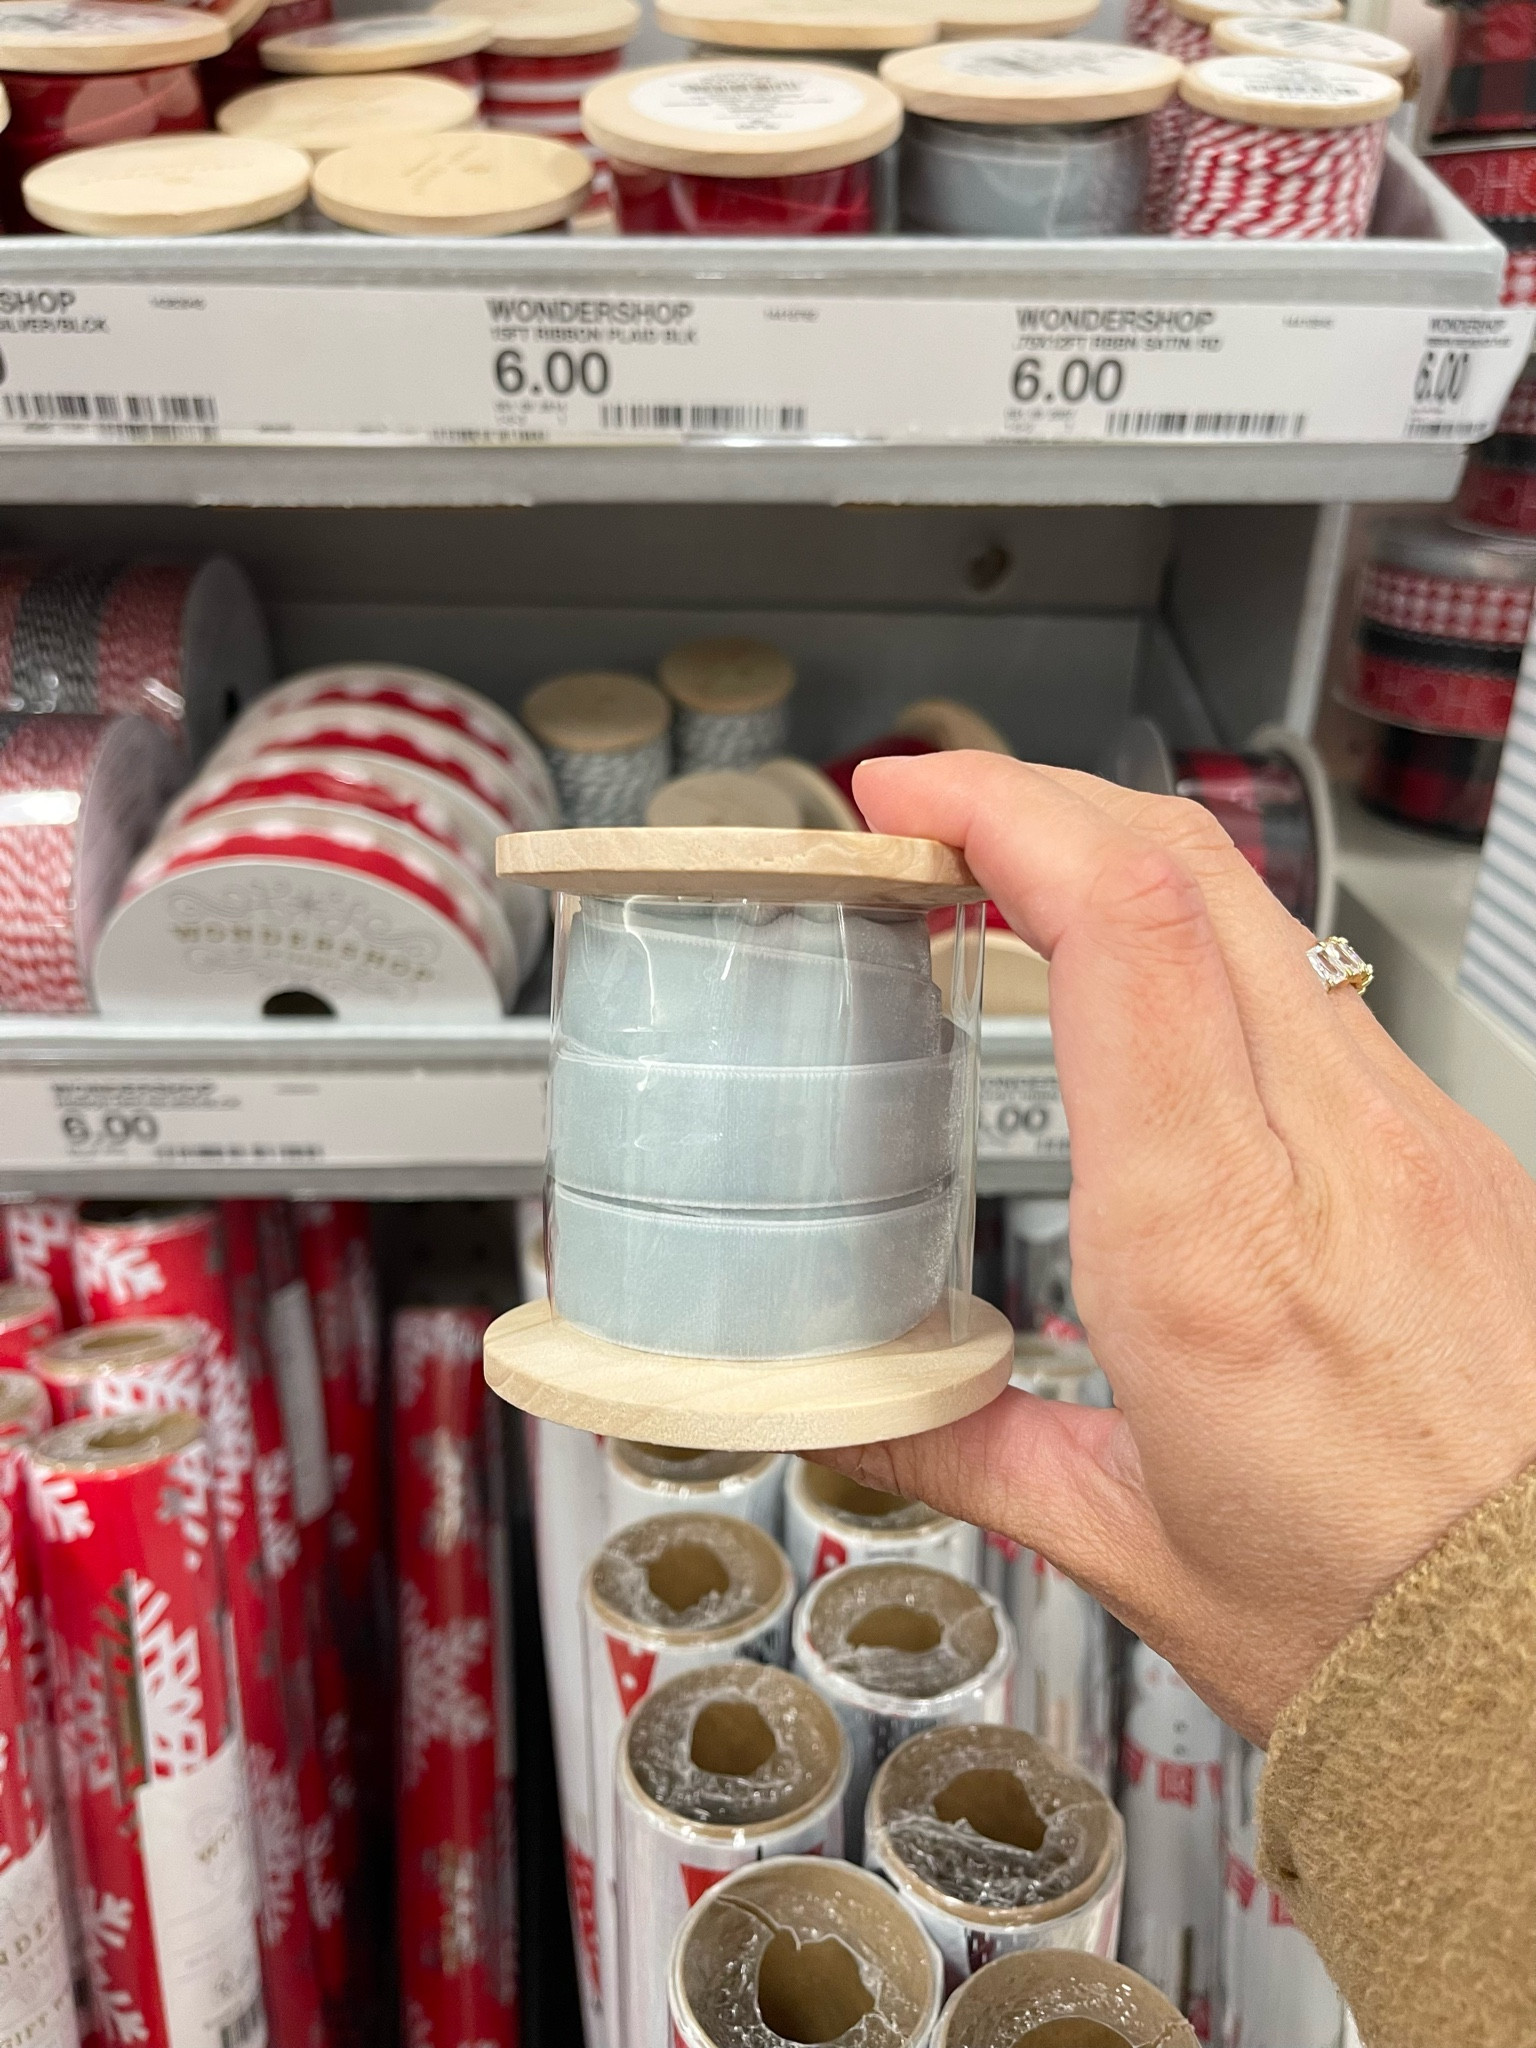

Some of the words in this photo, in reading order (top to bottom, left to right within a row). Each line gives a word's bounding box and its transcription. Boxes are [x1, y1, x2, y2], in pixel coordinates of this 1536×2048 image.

[0, 289, 77, 315] SHOP
[487, 299, 694, 324] WONDERSHOP
[1016, 308, 1215, 332] WONDERSHOP
[494, 350, 610, 396] 6.00
[1011, 357, 1124, 404] 6.00
